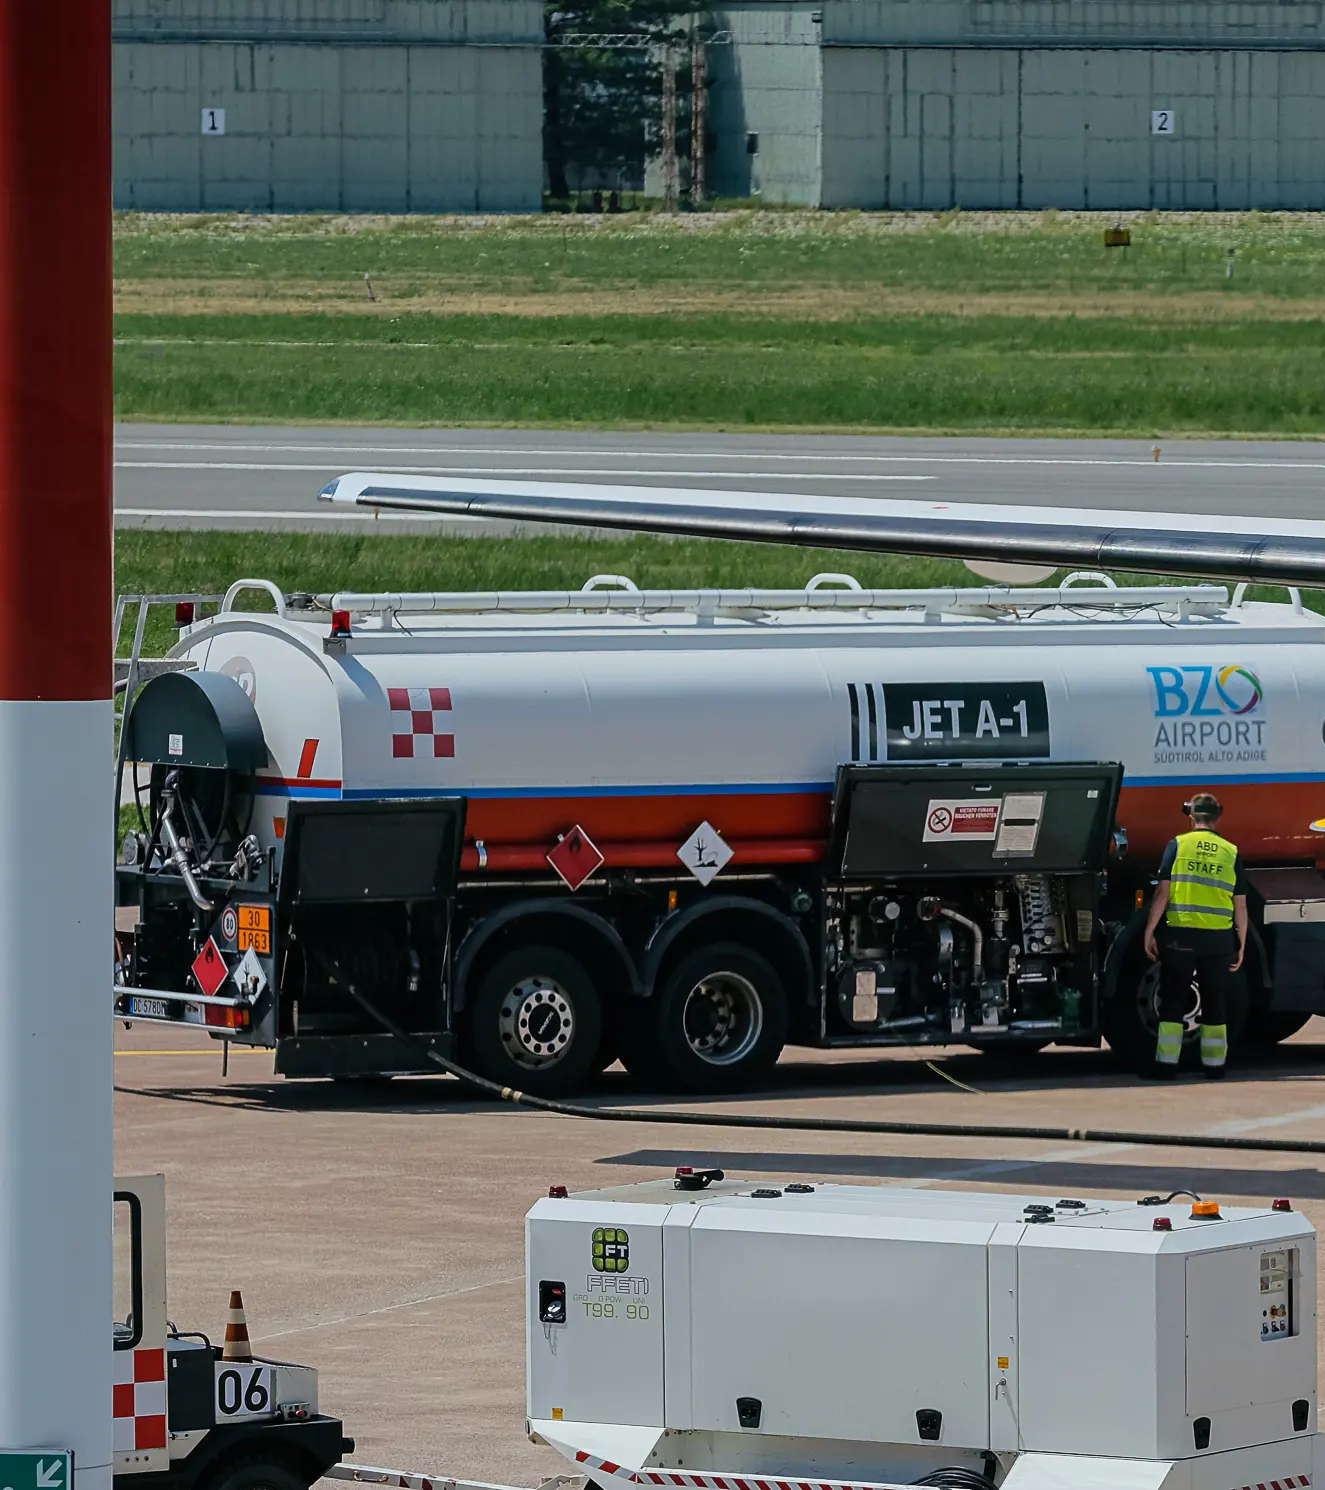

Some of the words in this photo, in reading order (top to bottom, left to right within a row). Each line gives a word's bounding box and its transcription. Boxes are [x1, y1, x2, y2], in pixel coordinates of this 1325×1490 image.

[208, 111, 218, 130] 1
[1158, 112, 1168, 131] 2
[1145, 665, 1263, 717] BZO
[902, 700, 965, 740] JET
[975, 699, 1029, 739] A-1
[1154, 720, 1267, 748] AIRPORT
[1153, 750, 1205, 764] SÜDTIROL
[1207, 750, 1234, 763] ALTO
[1236, 749, 1268, 762] ADIGE
[1196, 840, 1219, 852] ABD
[1187, 861, 1223, 875] STAFF
[225, 918, 234, 931] 80
[248, 910, 261, 926] 30
[242, 931, 267, 950] 1863
[605, 1244, 628, 1257] FT
[218, 1367, 269, 1415] 06
